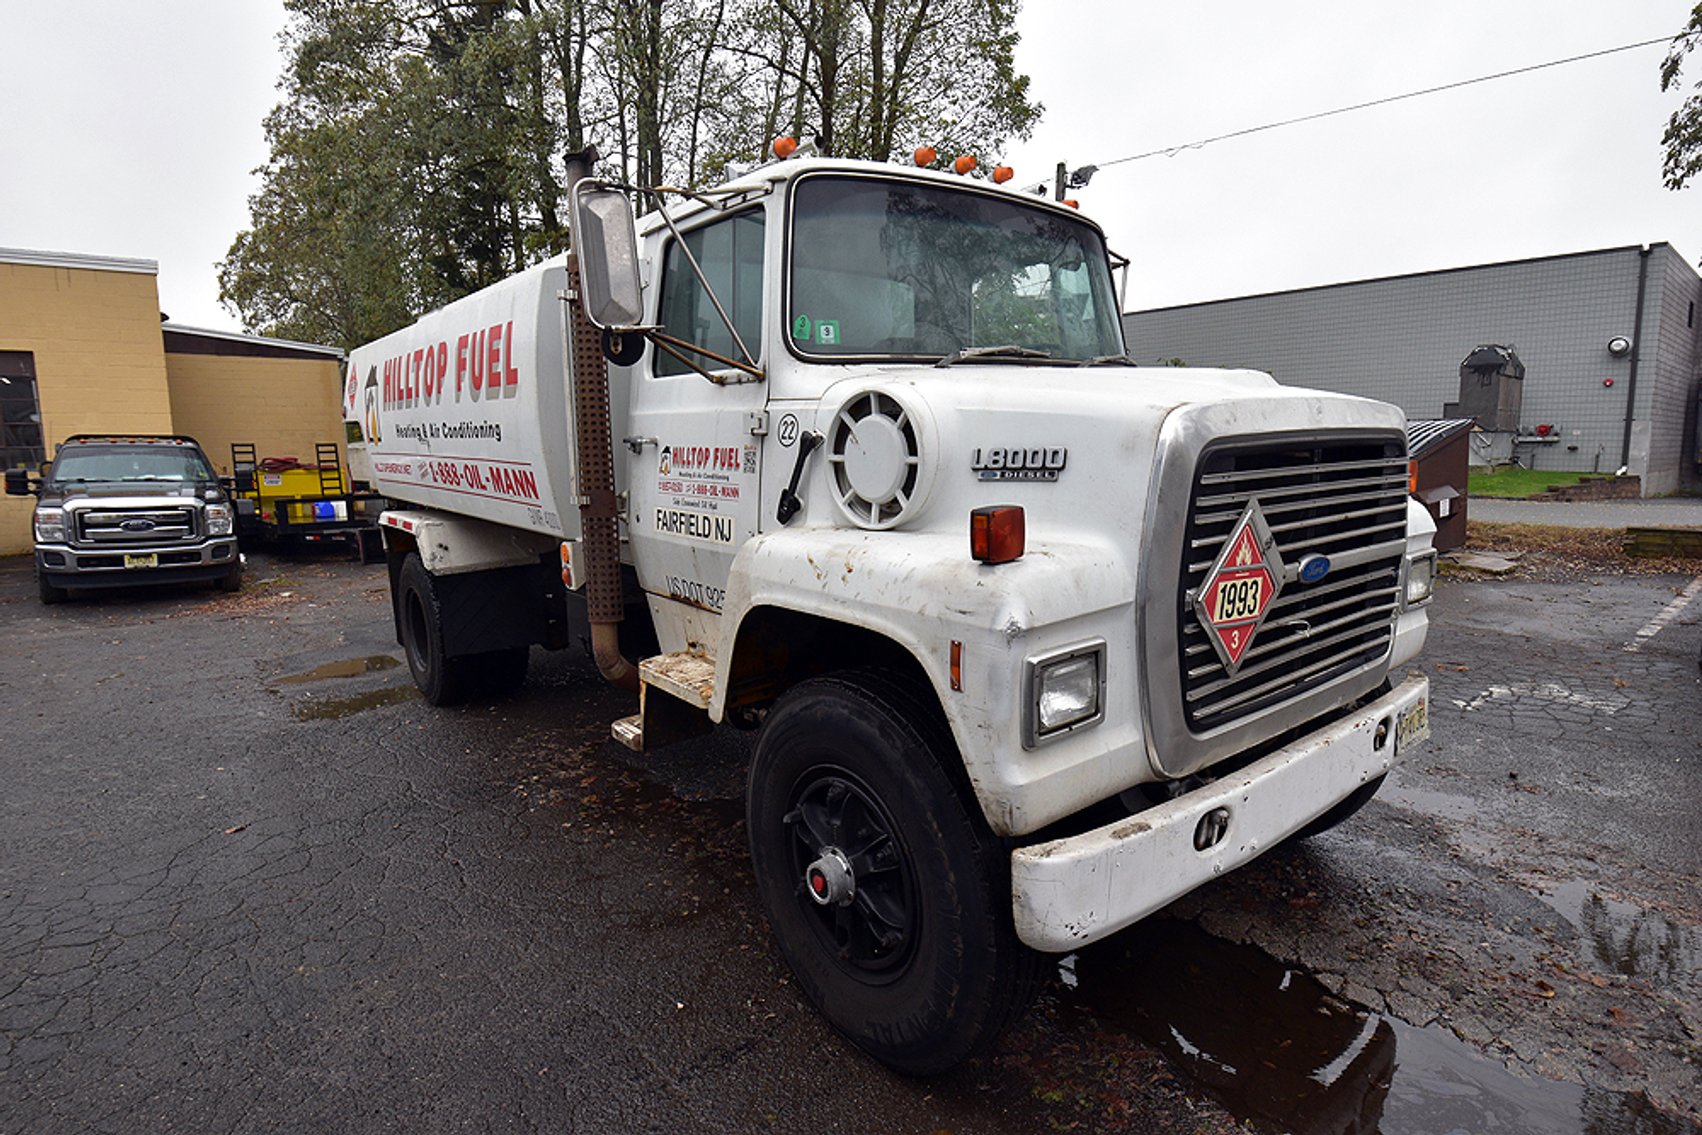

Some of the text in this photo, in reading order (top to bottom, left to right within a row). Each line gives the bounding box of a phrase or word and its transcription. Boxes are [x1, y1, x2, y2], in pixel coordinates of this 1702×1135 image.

[383, 320, 518, 407] HILLTOP FUEL
[395, 423, 421, 442] Heating
[429, 423, 440, 438] Air
[442, 420, 502, 442] Conditioning
[781, 420, 796, 440] 22
[672, 446, 741, 470] HILLTOP FUEL
[971, 447, 1067, 471] L8000
[656, 508, 732, 542] FAIRFIELD NJ
[1219, 579, 1259, 620] 1993
[1231, 630, 1240, 649] 3
